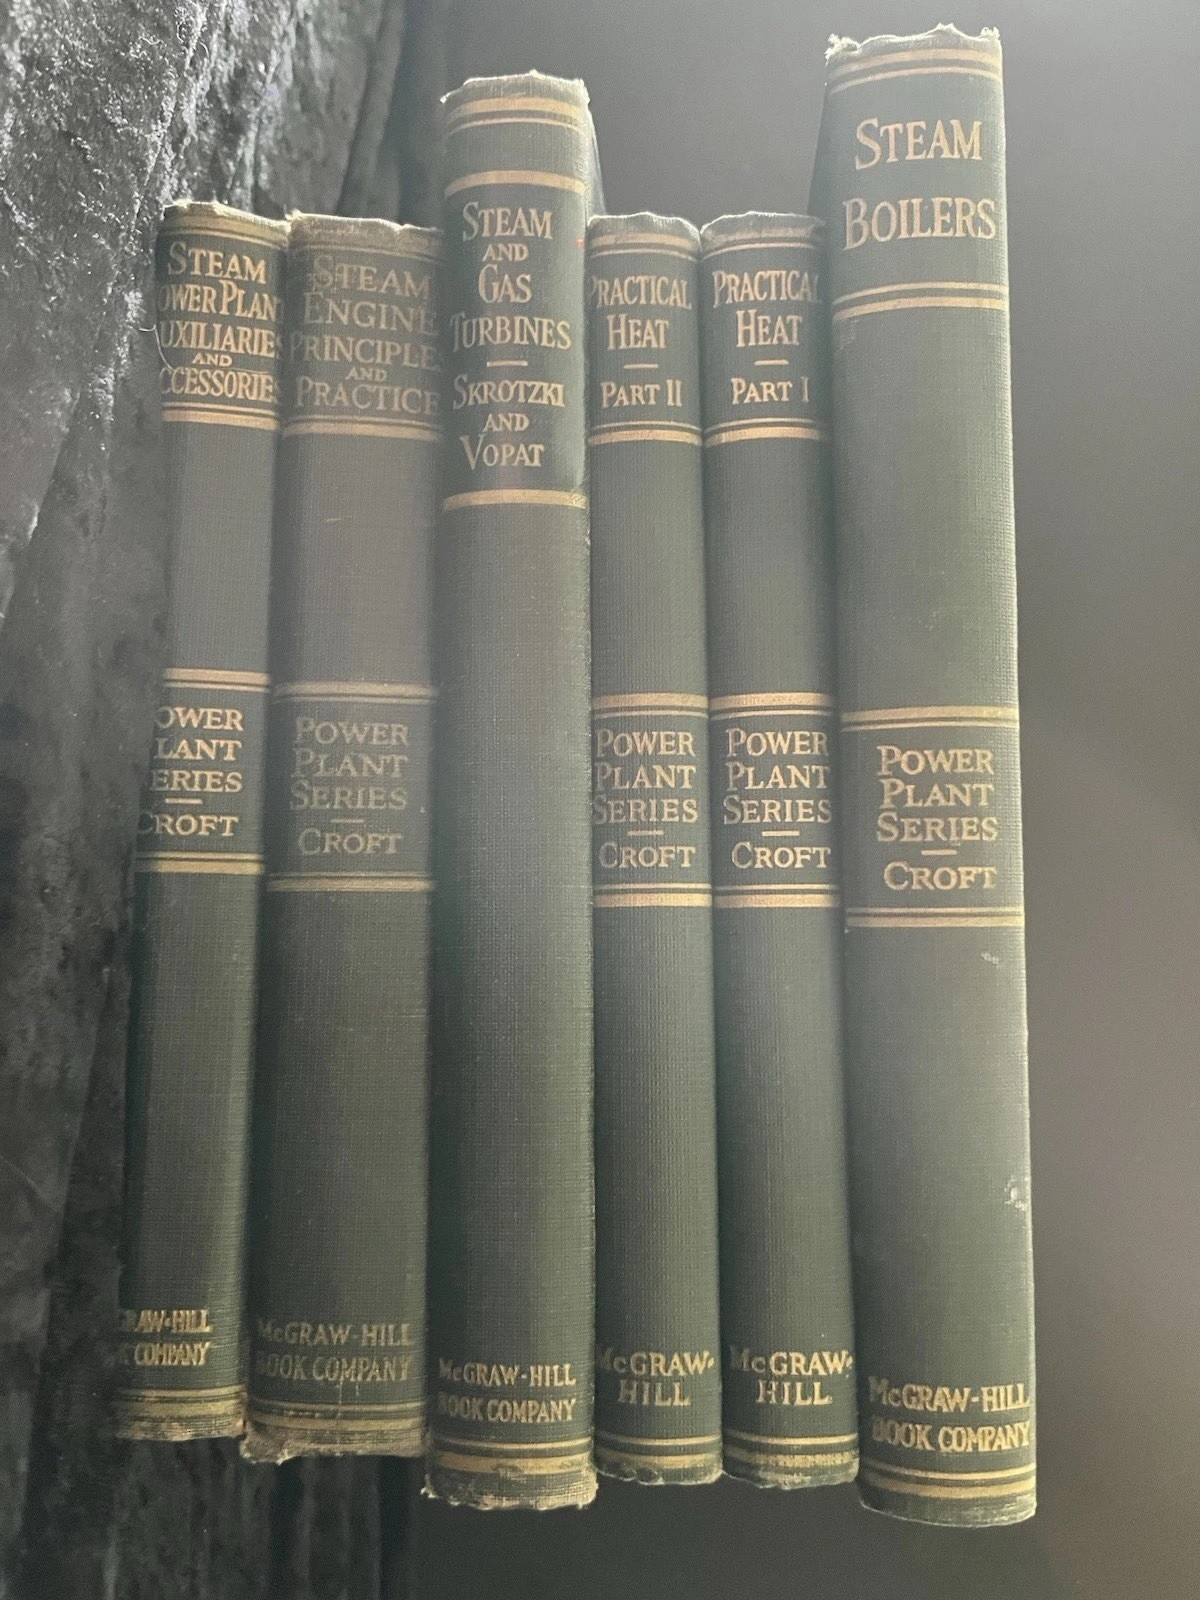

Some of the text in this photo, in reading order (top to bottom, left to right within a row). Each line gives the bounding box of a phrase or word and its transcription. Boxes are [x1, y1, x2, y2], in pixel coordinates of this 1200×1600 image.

[854, 117, 984, 171] STEAM
[463, 201, 554, 242] STEAM
[842, 197, 998, 251] BOILERS
[168, 241, 267, 285] STEAM
[482, 243, 530, 263] AND
[312, 254, 431, 299] STEAM
[478, 264, 533, 304] GAS
[159, 279, 280, 323] OWER PLAN
[590, 275, 692, 311] PRACTICAL
[160, 320, 281, 359] UXILIARIE
[451, 312, 573, 354] TURBINES
[606, 313, 670, 350] HEAT
[736, 309, 803, 348] HEAT
[192, 352, 233, 367] AND
[290, 331, 441, 371] PRINCIPLE
[160, 367, 279, 405] CCESSORIE
[345, 367, 387, 382] AND
[297, 376, 440, 415] PRACTICE
[453, 373, 566, 410] SKROTZKI
[601, 379, 683, 408] PART II
[731, 376, 810, 405] PART I
[482, 412, 530, 432] AND
[460, 434, 545, 471] VOPAT
[155, 705, 244, 731] OWER
[296, 716, 410, 747] POWER
[153, 737, 242, 761] LANT
[595, 728, 696, 758] POWER
[725, 727, 829, 757] POWER
[293, 748, 408, 778] PLANT
[595, 761, 697, 791] PLANT
[725, 761, 830, 791] PLANT
[876, 745, 995, 776] POWER
[150, 769, 243, 793] ERIES
[290, 780, 408, 811] SERIES
[879, 778, 995, 809] PLANT
[593, 793, 699, 825] SERIES
[723, 793, 833, 825] SERIES
[299, 828, 403, 856] CROFT
[876, 811, 999, 842] SERIES
[599, 841, 697, 869] CROFT
[732, 841, 832, 870] CROFT
[884, 861, 997, 890] CROFT
[312, 1355, 414, 1383] COMPANY
[619, 1379, 692, 1407] HILL
[757, 1380, 833, 1407] HILL
[868, 1376, 1031, 1413] McGRAW-HILL
[486, 1397, 578, 1423] COMPANY
[871, 1415, 1031, 1455] BOOK COMPANY
